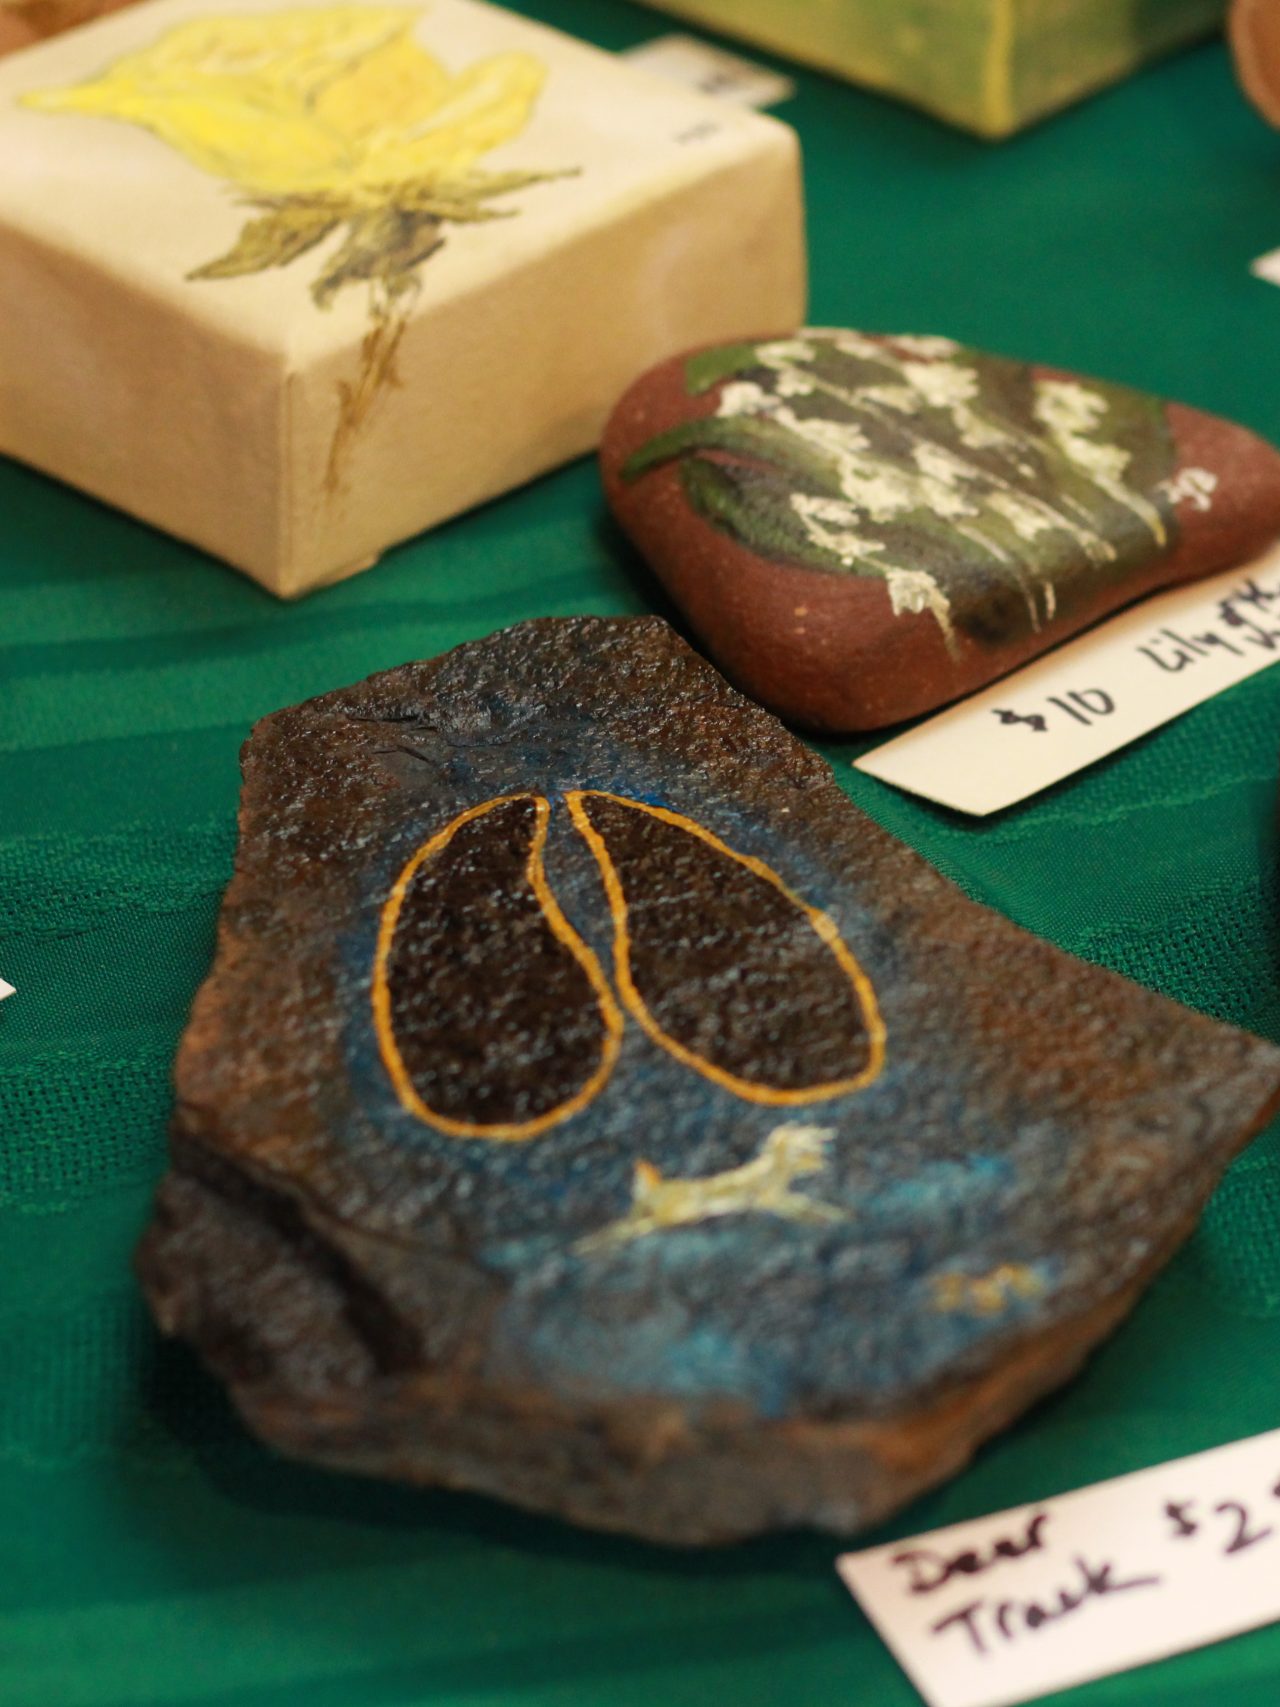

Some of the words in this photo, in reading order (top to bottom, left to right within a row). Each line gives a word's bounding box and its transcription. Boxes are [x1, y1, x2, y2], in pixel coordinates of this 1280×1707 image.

[1136, 627, 1246, 675] Lily
[892, 1514, 1047, 1594] Deer
[930, 1556, 1162, 1655] Track
